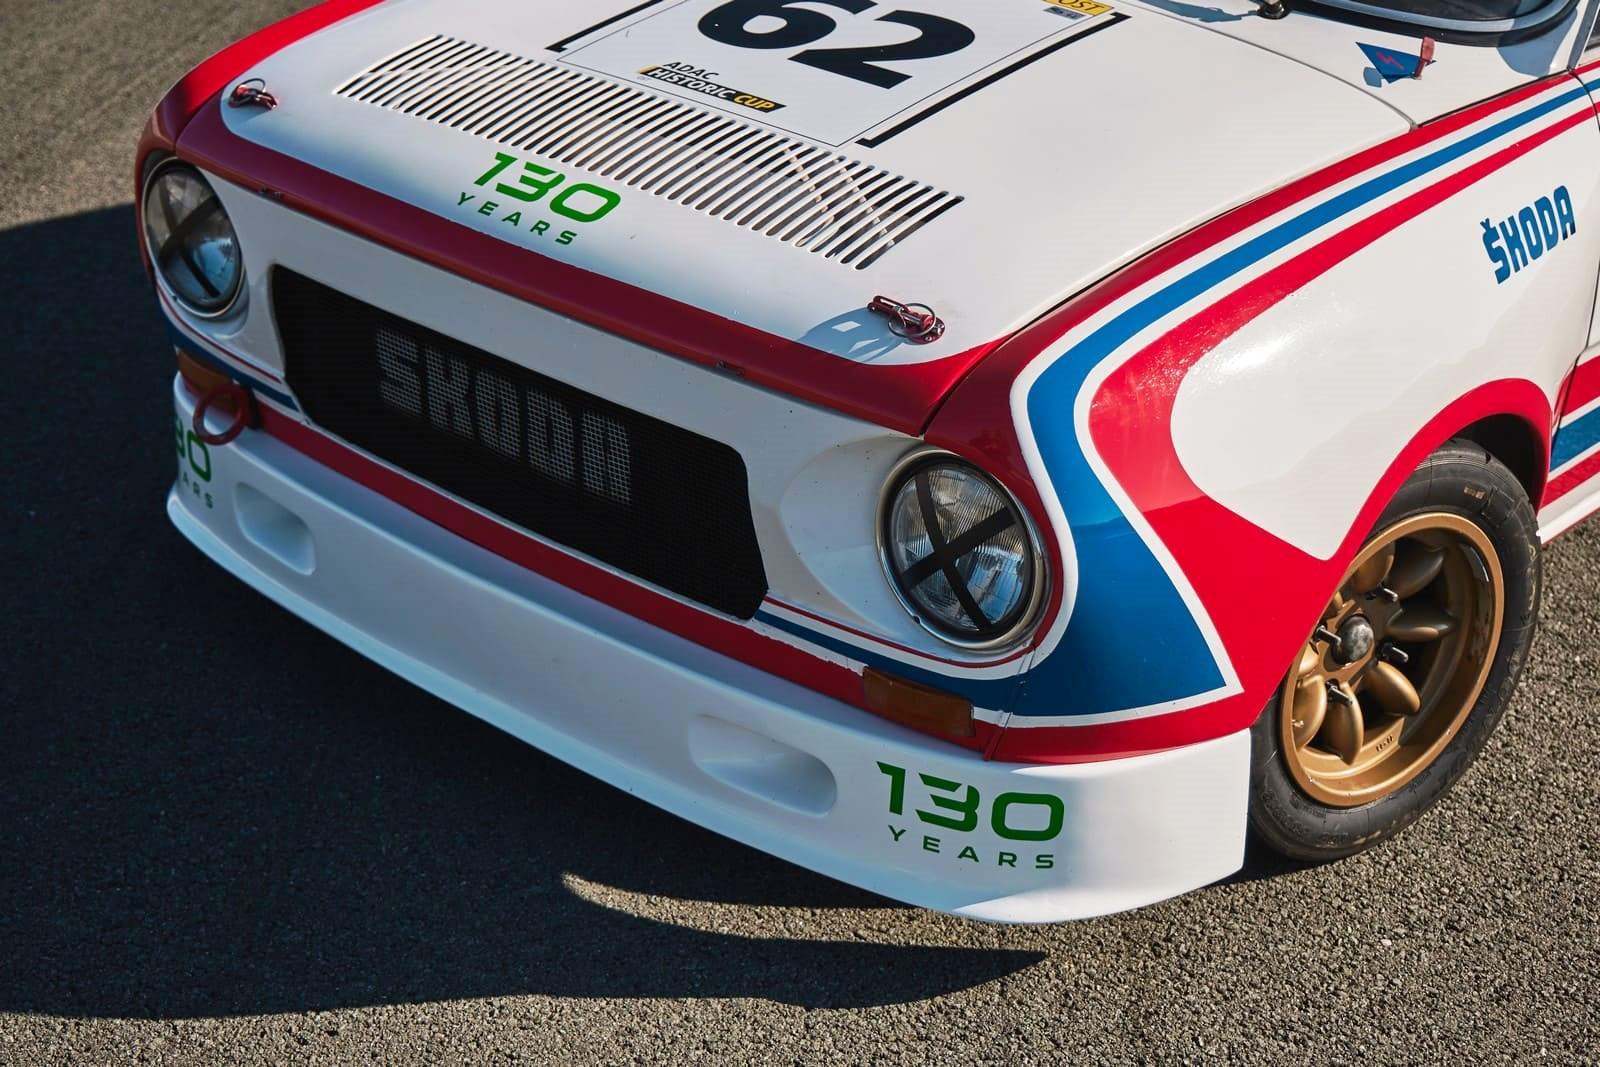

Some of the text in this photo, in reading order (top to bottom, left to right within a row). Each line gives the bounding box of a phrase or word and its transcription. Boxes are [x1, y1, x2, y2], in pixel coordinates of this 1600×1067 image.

[662, 61, 719, 80] ADAC
[697, 0, 975, 90] 62
[648, 68, 775, 109] HISTORIC CUP
[457, 191, 577, 245] YEARS
[473, 151, 621, 223] 130
[1480, 185, 1576, 284] ŠKODA
[174, 416, 212, 481] 30
[376, 328, 632, 505] SKODA
[877, 761, 1064, 841] 130
[888, 825, 1054, 869] YEARS
